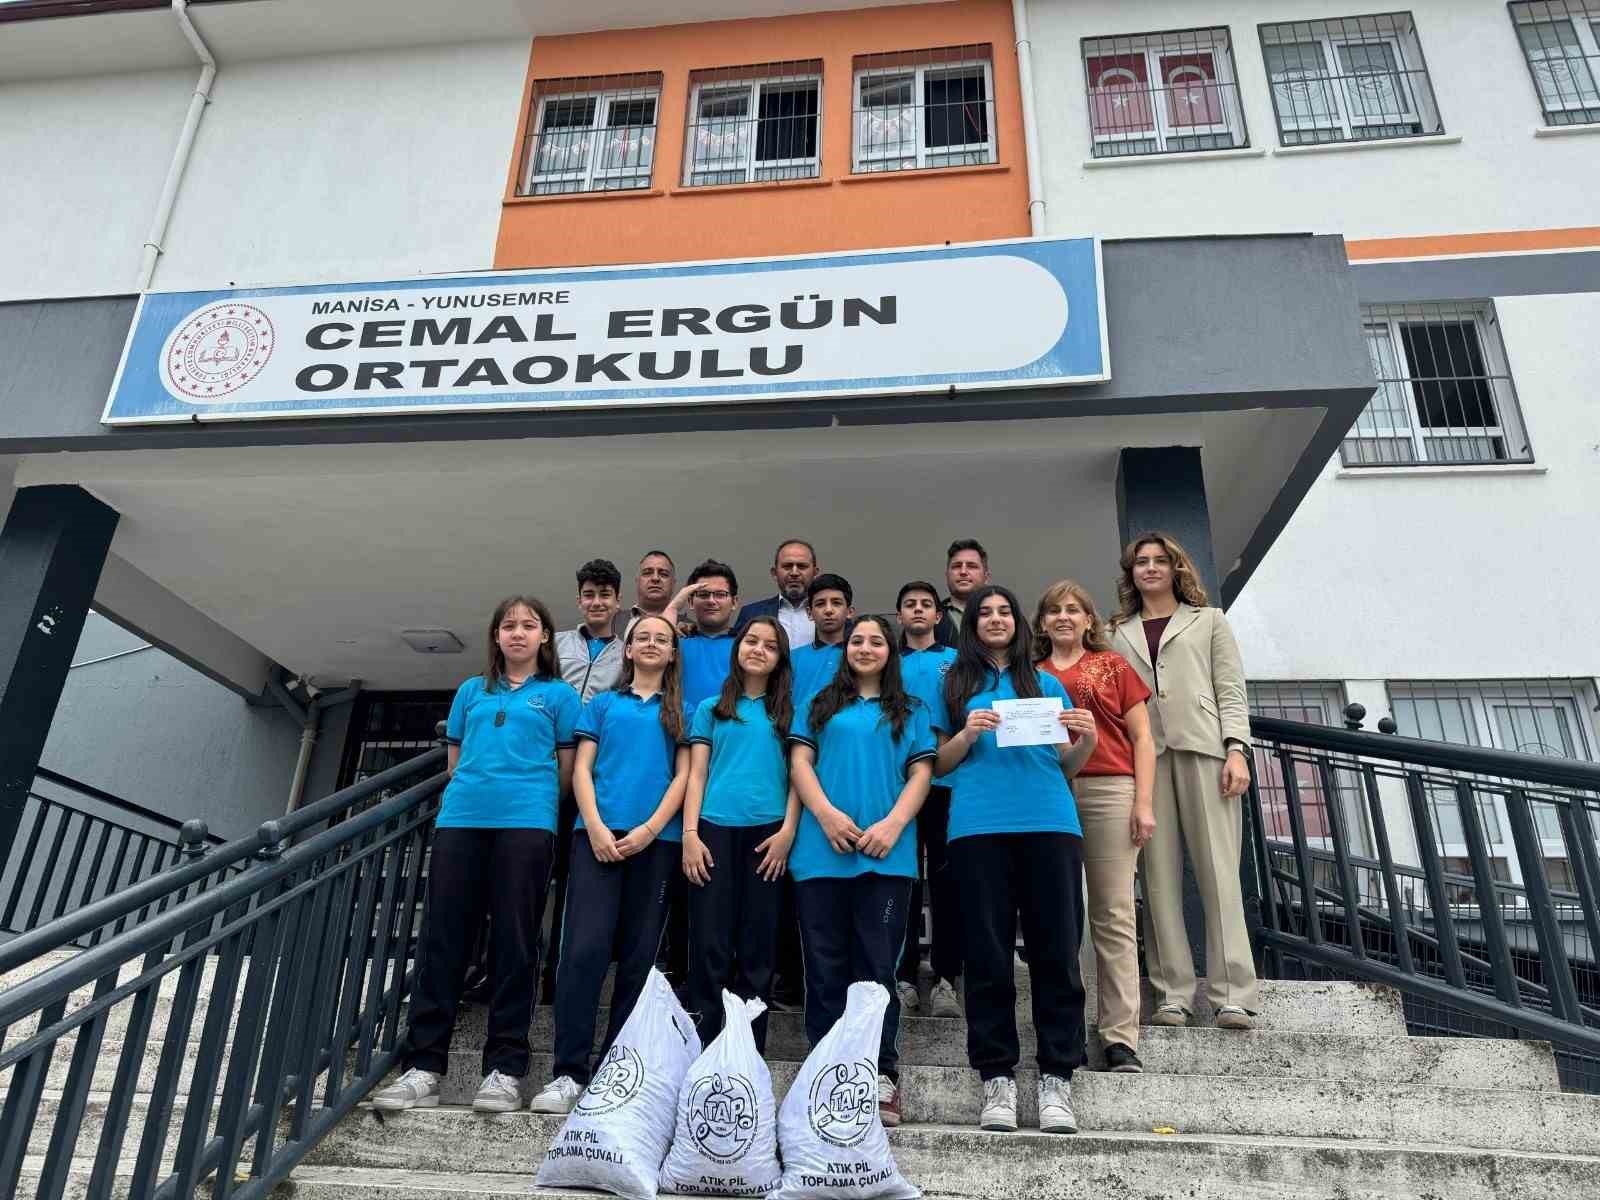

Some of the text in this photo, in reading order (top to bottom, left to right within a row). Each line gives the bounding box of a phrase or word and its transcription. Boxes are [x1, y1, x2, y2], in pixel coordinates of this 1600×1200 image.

[312, 297, 400, 315] MANİSA
[421, 290, 570, 310] YUNUSEMRE
[305, 294, 897, 350] CEMAL ERGÜN
[295, 344, 803, 392] ORTAOKULU
[830, 1081, 870, 1112] TAP
[704, 1096, 745, 1124] TAP
[564, 1129, 599, 1144] ATIK PİL
[548, 1146, 623, 1164] TOPLAMA ÇUVALI
[801, 1166, 893, 1188] TOPLAMA ÇUVALI
[827, 1160, 872, 1174] ATIK PİL
[699, 1175, 747, 1186] ATIK PİL
